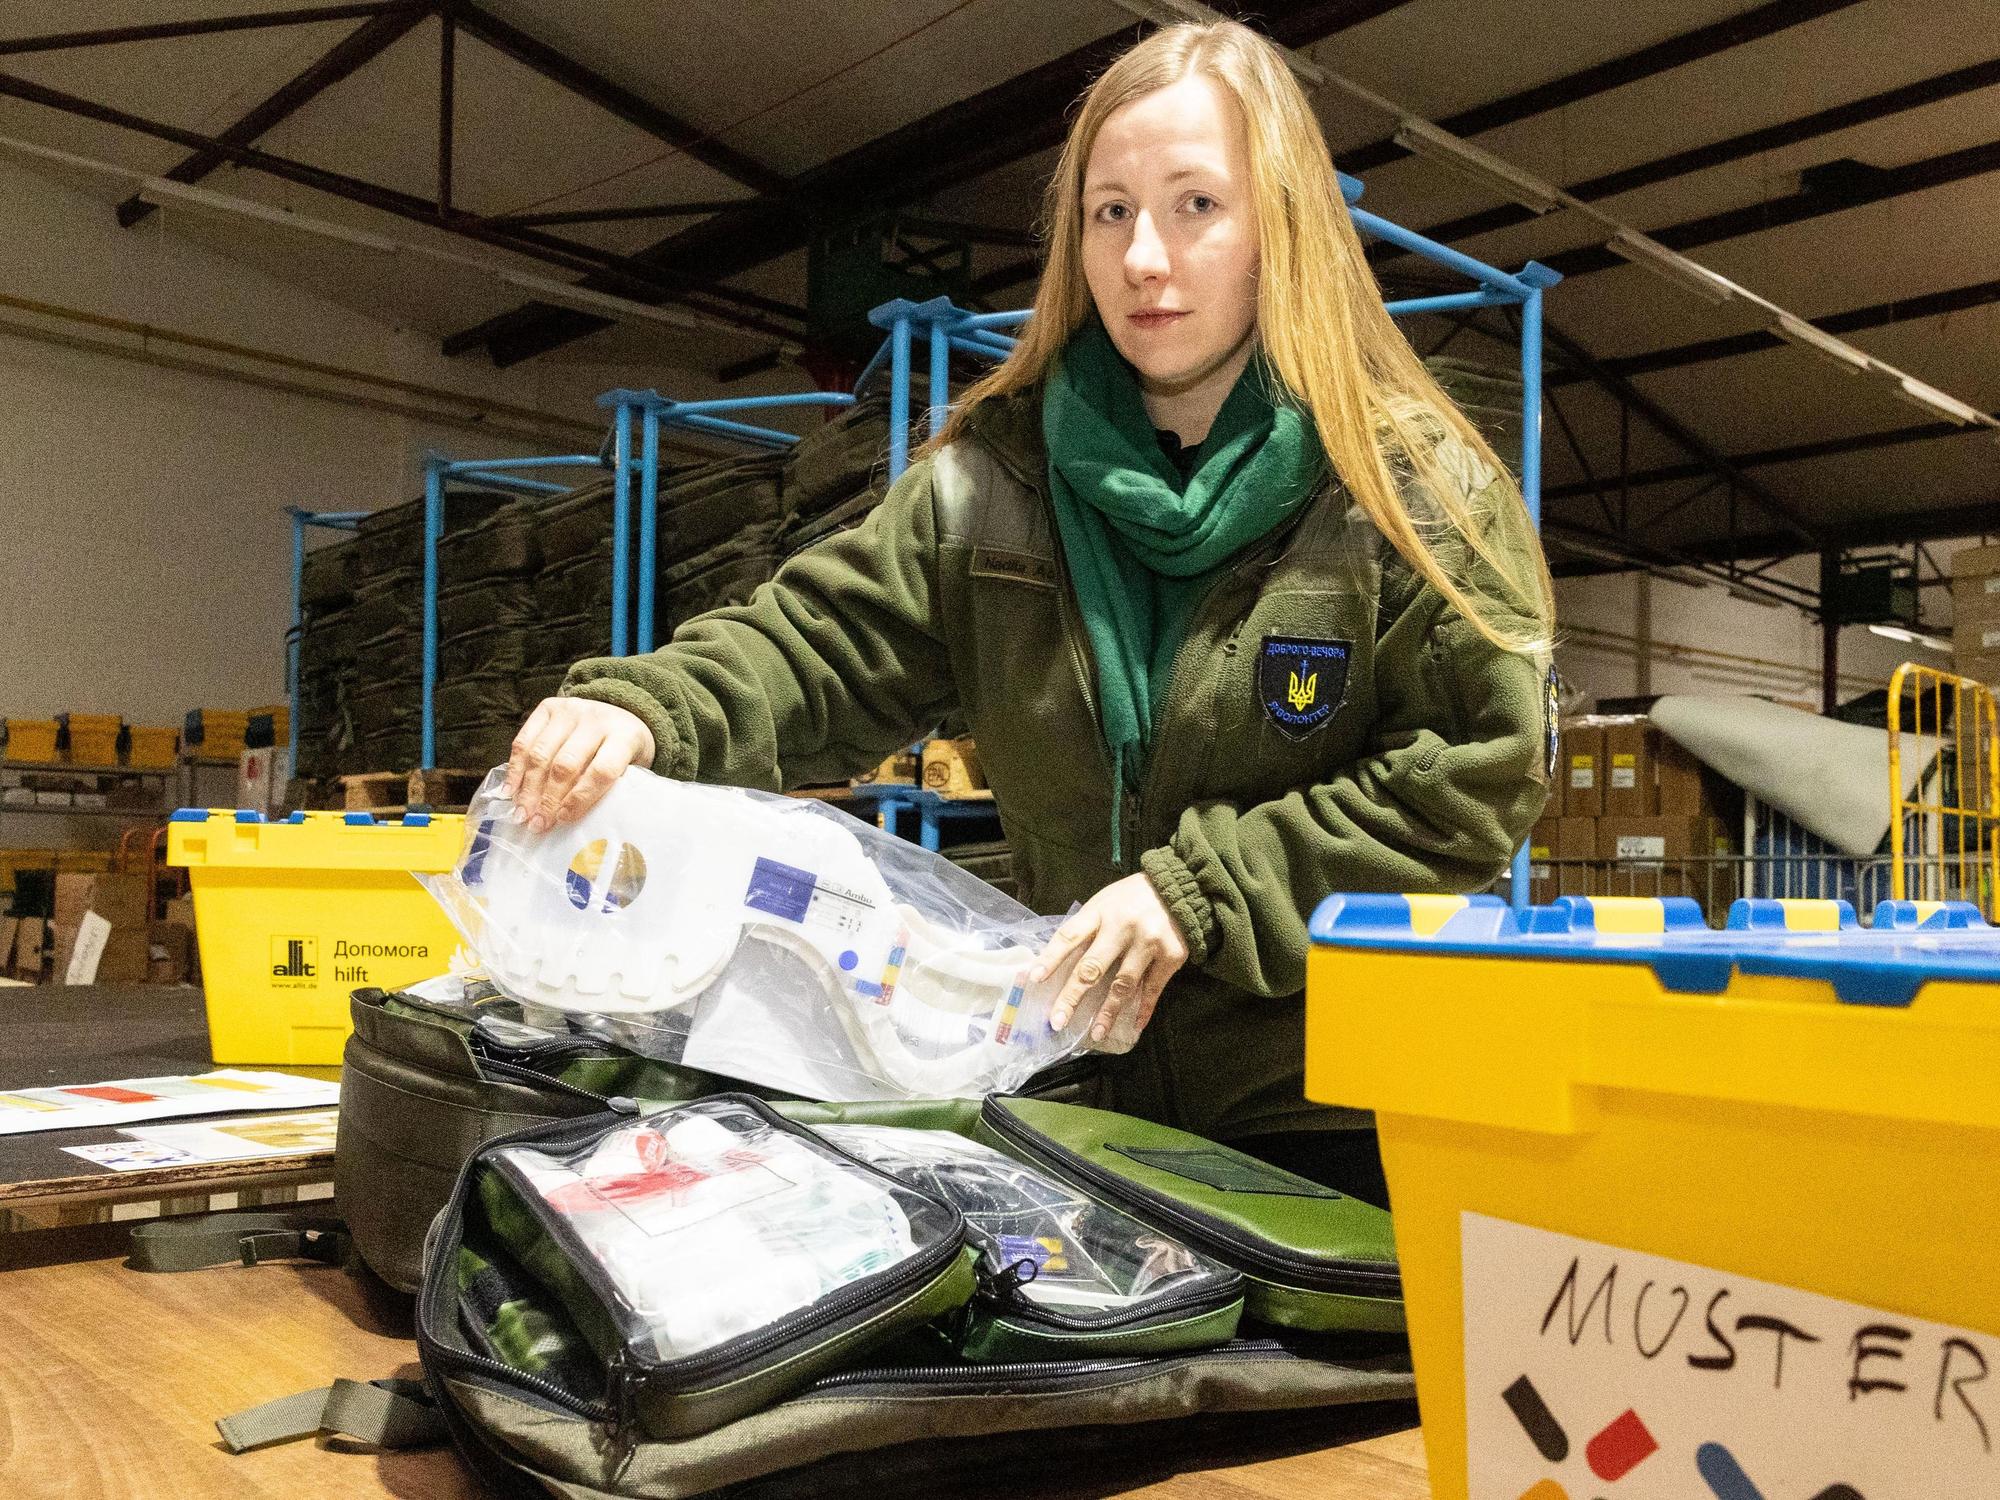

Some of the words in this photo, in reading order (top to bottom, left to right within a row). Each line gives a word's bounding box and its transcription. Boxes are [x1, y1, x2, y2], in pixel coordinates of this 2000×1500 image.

[844, 888, 873, 904] Ambu
[333, 940, 429, 959] Допомога
[335, 966, 369, 983] hilft
[1540, 1256, 1991, 1454] MUSTER
